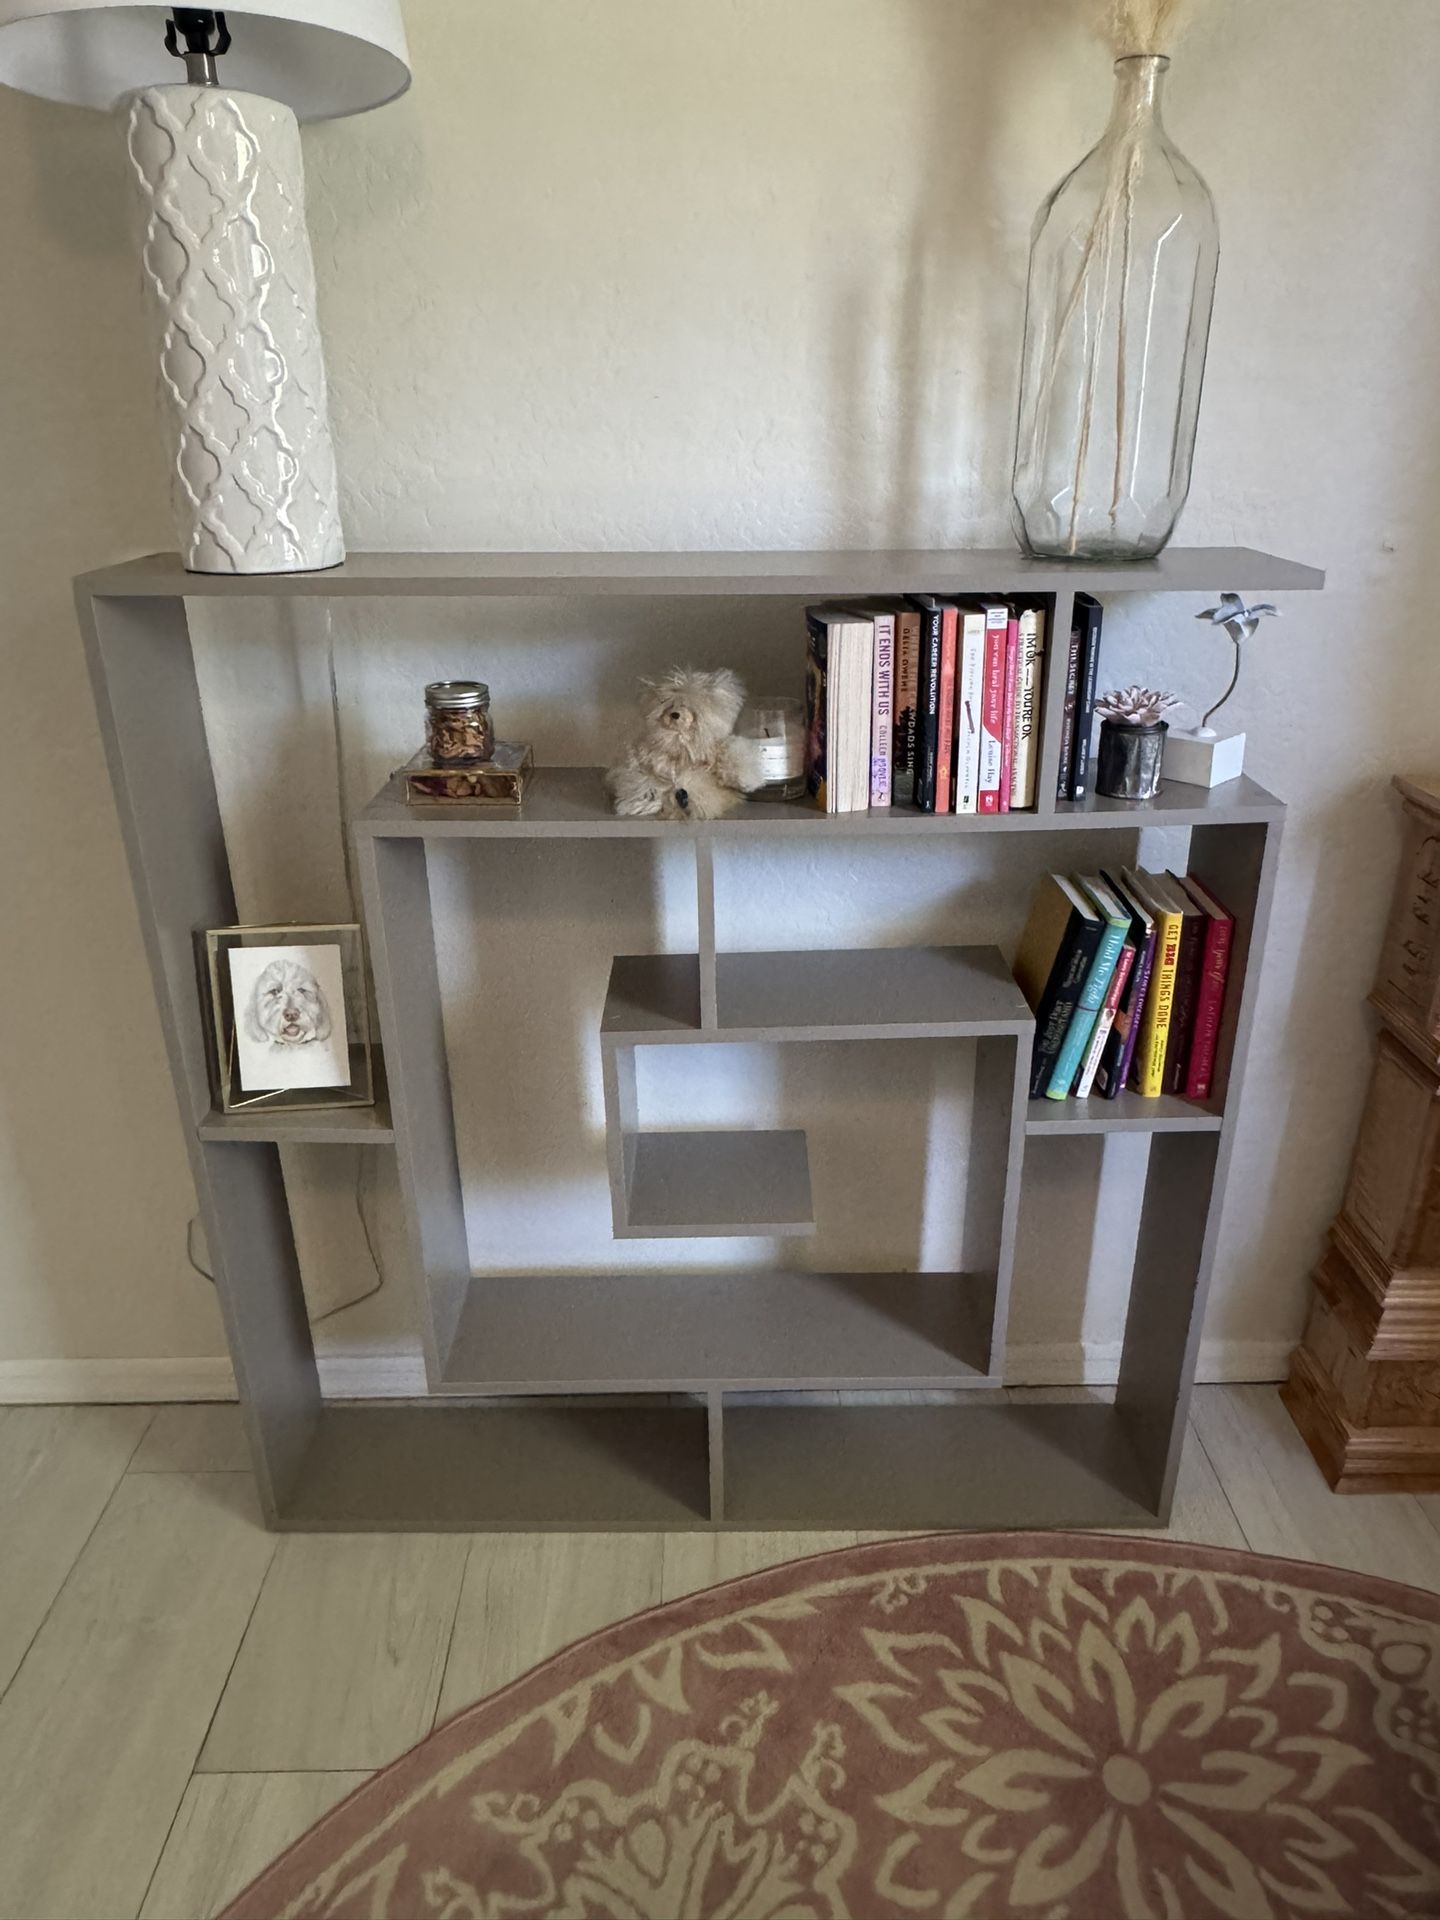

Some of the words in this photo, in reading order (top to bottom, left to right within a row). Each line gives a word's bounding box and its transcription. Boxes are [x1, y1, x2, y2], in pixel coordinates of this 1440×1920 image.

[878, 624, 890, 635] IT
[931, 615, 939, 635] YOUR
[878, 637, 890, 667] ENDS
[901, 627, 910, 656] DELIA
[930, 637, 938, 667] CAREER
[991, 634, 1000, 650] you
[991, 652, 999, 667] can
[1025, 650, 1036, 666] OK
[1070, 644, 1078, 662] THE
[878, 670, 889, 698] WITH
[900, 658, 909, 692] OWENS
[990, 669, 1000, 687] heal
[1068, 663, 1076, 695] SECRET
[929, 668, 937, 715] REVOLUTION
[988, 688, 998, 708] your
[877, 701, 889, 715] US
[989, 710, 997, 724] life
[878, 724, 887, 755] COLLEEN
[1021, 724, 1031, 740] OK
[987, 739, 996, 766] Louise
[985, 768, 995, 783] Hay
[1167, 924, 1179, 941] GET
[1103, 934, 1120, 959] Hold
[1164, 943, 1177, 966] BIG
[1097, 960, 1109, 976] Me
[1084, 977, 1104, 1004] Tight
[1158, 969, 1174, 1002] THINGS
[1156, 1004, 1169, 1029] DONE
